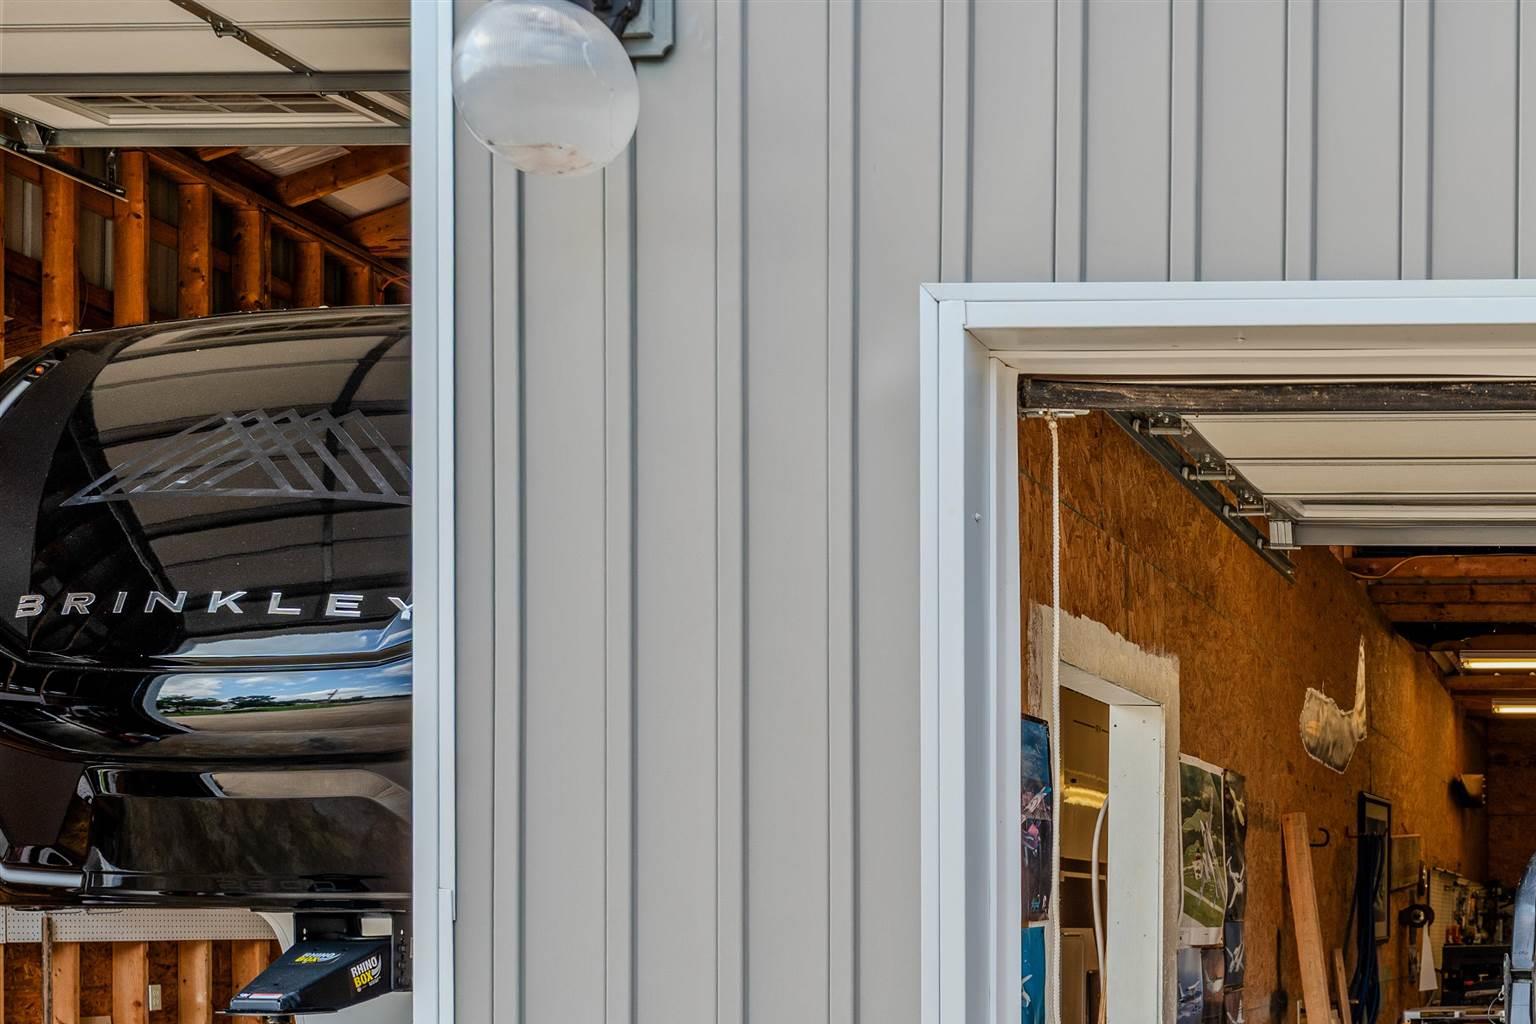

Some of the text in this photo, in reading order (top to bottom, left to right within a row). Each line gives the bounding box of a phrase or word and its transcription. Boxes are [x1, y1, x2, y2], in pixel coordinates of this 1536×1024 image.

[15, 591, 412, 620] BRINKLEY
[350, 956, 378, 978] RHINO
[353, 970, 374, 988] BOX
